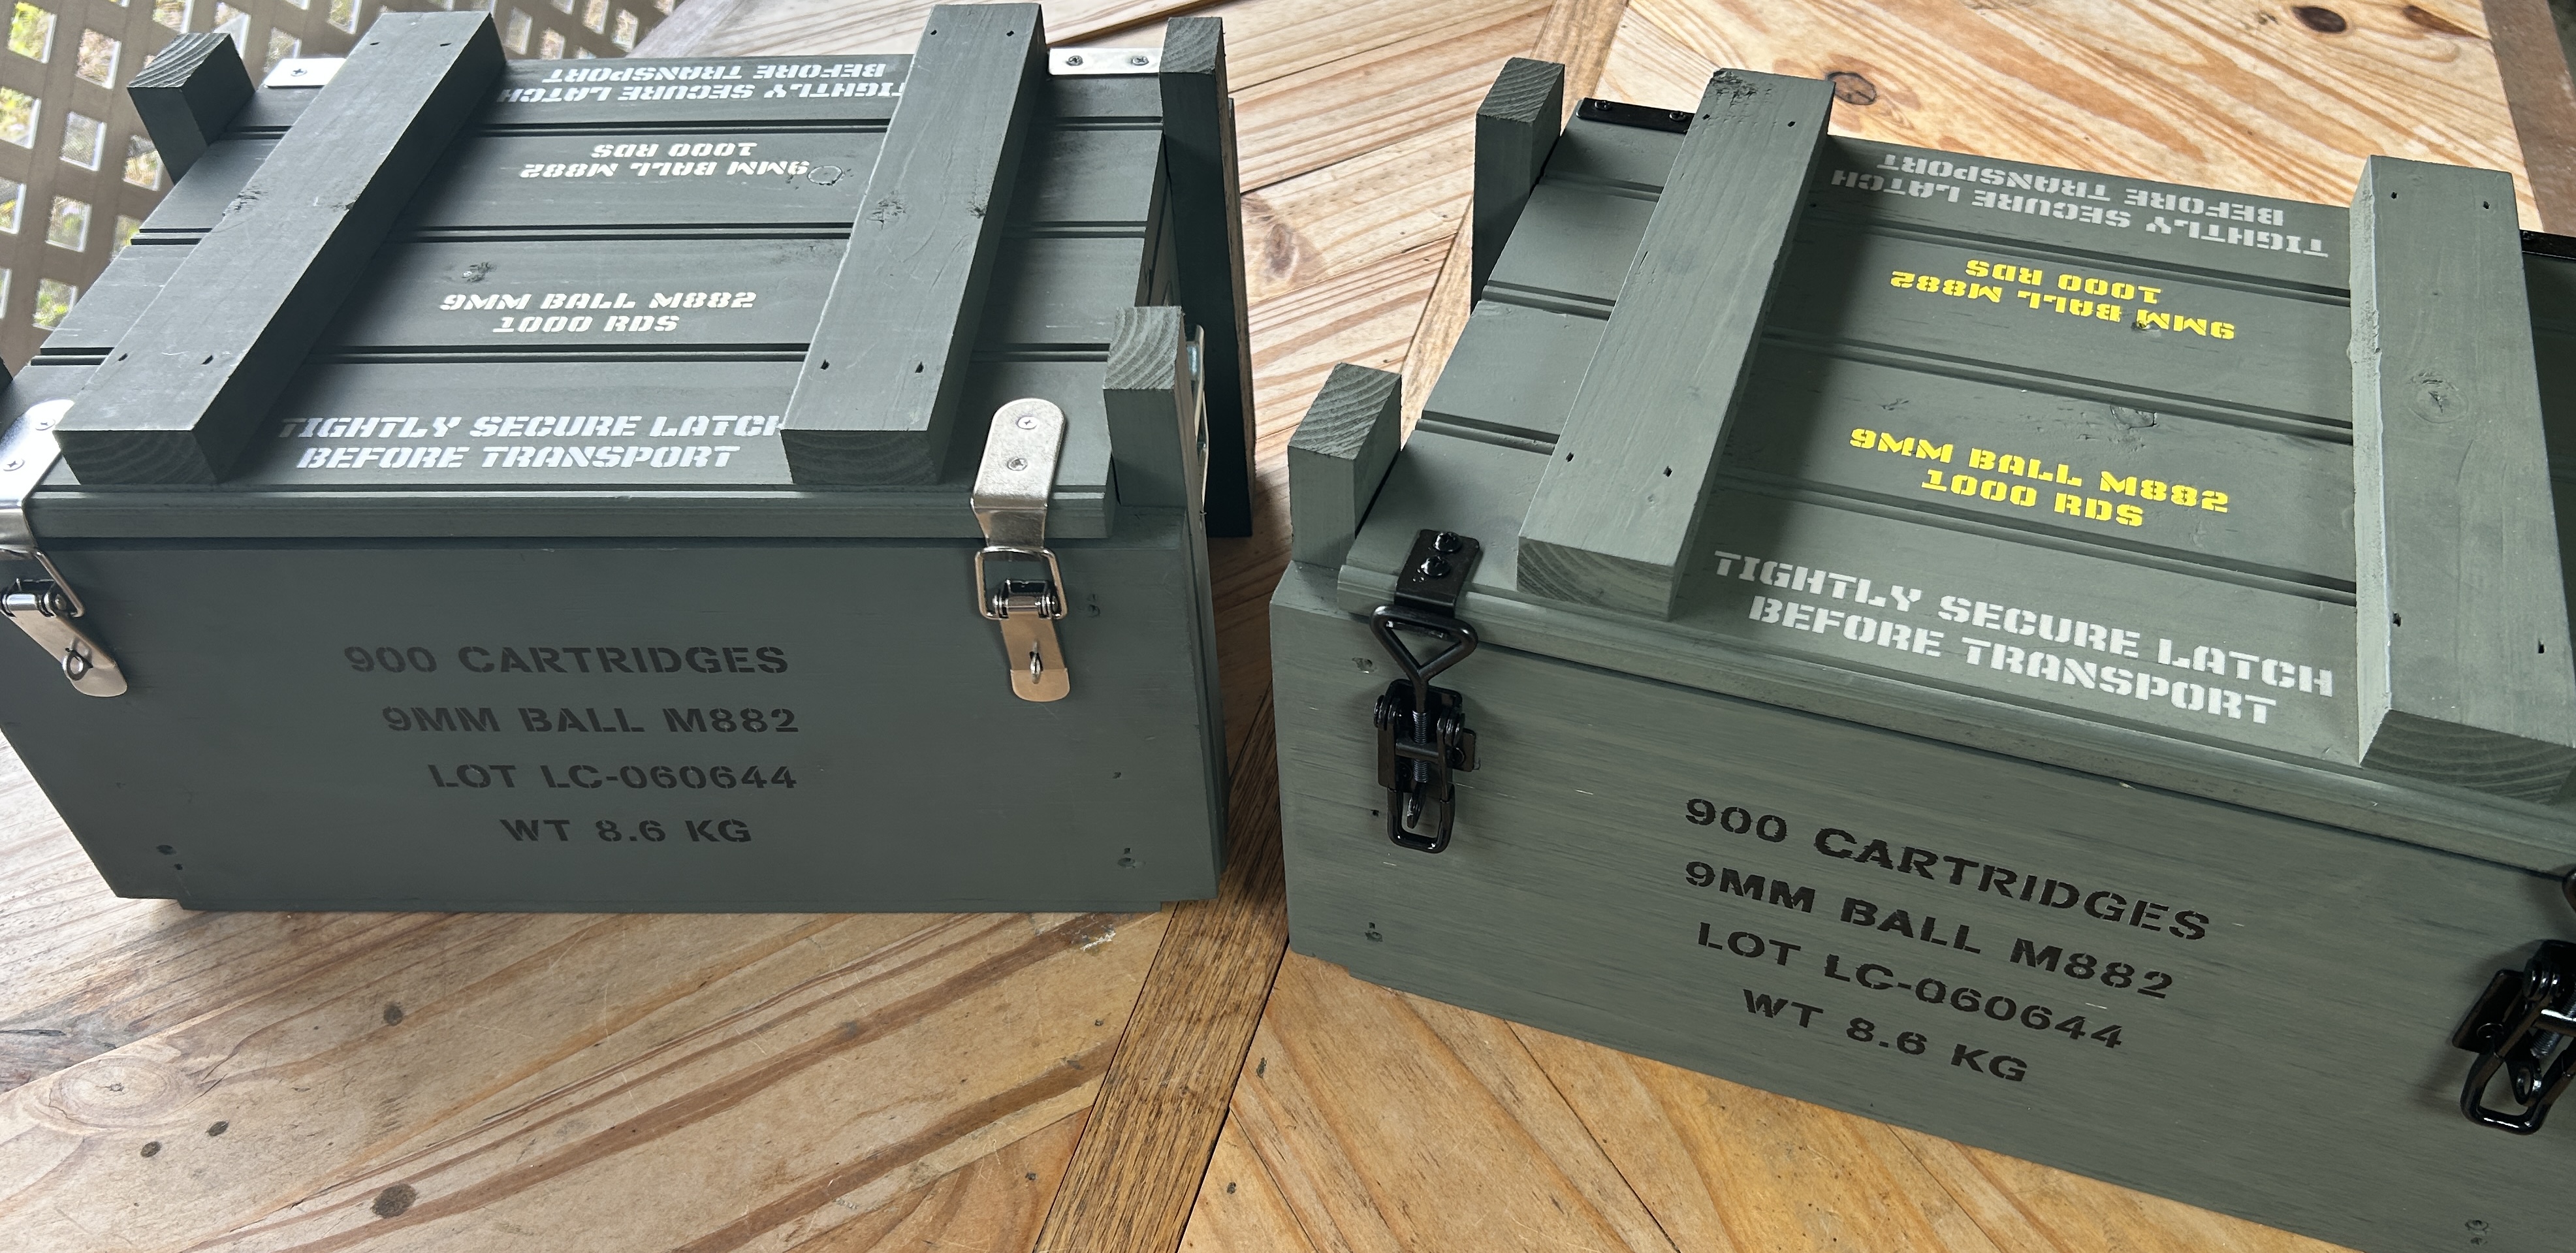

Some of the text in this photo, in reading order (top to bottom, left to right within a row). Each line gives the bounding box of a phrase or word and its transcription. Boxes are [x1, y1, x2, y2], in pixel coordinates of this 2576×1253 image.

[541, 63, 887, 84] BEFORE TRANSPORT
[496, 86, 612, 103] LATCH
[617, 84, 755, 101] SECURE
[590, 142, 757, 158] 1000 RDS
[520, 160, 810, 178] 9MM BALL M882
[1877, 153, 2284, 226] BEFORE TRANSPORT
[1831, 170, 2329, 257] TIGHTLY SECURE LATCH
[1965, 259, 2162, 304] 1000 RDS
[440, 291, 757, 310] 9MM BALL M882
[1890, 271, 2235, 340] 9MM BALL M882
[492, 315, 680, 333] 1000 RDS
[278, 417, 462, 438] TIGHTLY
[469, 415, 642, 437] SECURE
[296, 445, 740, 468] BEFORE TRANSPORT
[1849, 428, 2229, 514] 9MM BALL M882
[1921, 468, 2143, 527] 1000 RDS
[1713, 549, 2334, 697] TIGHTLY SECURE LATCH
[344, 646, 788, 674] 900 CARTRIDGES
[1747, 595, 2277, 724] BEFORE TRANSPORT
[382, 706, 799, 733] 9MM BALL M882
[428, 764, 797, 789] LOT LC-060644
[500, 819, 752, 843] WT 8.6 KG
[1685, 798, 2211, 942] 900 CARTRIDGES
[1685, 861, 2174, 1000] 9MM BALL M882
[1696, 921, 2124, 1049] LOT LC-060644
[1743, 989, 2028, 1083] WT 8.6 KG
